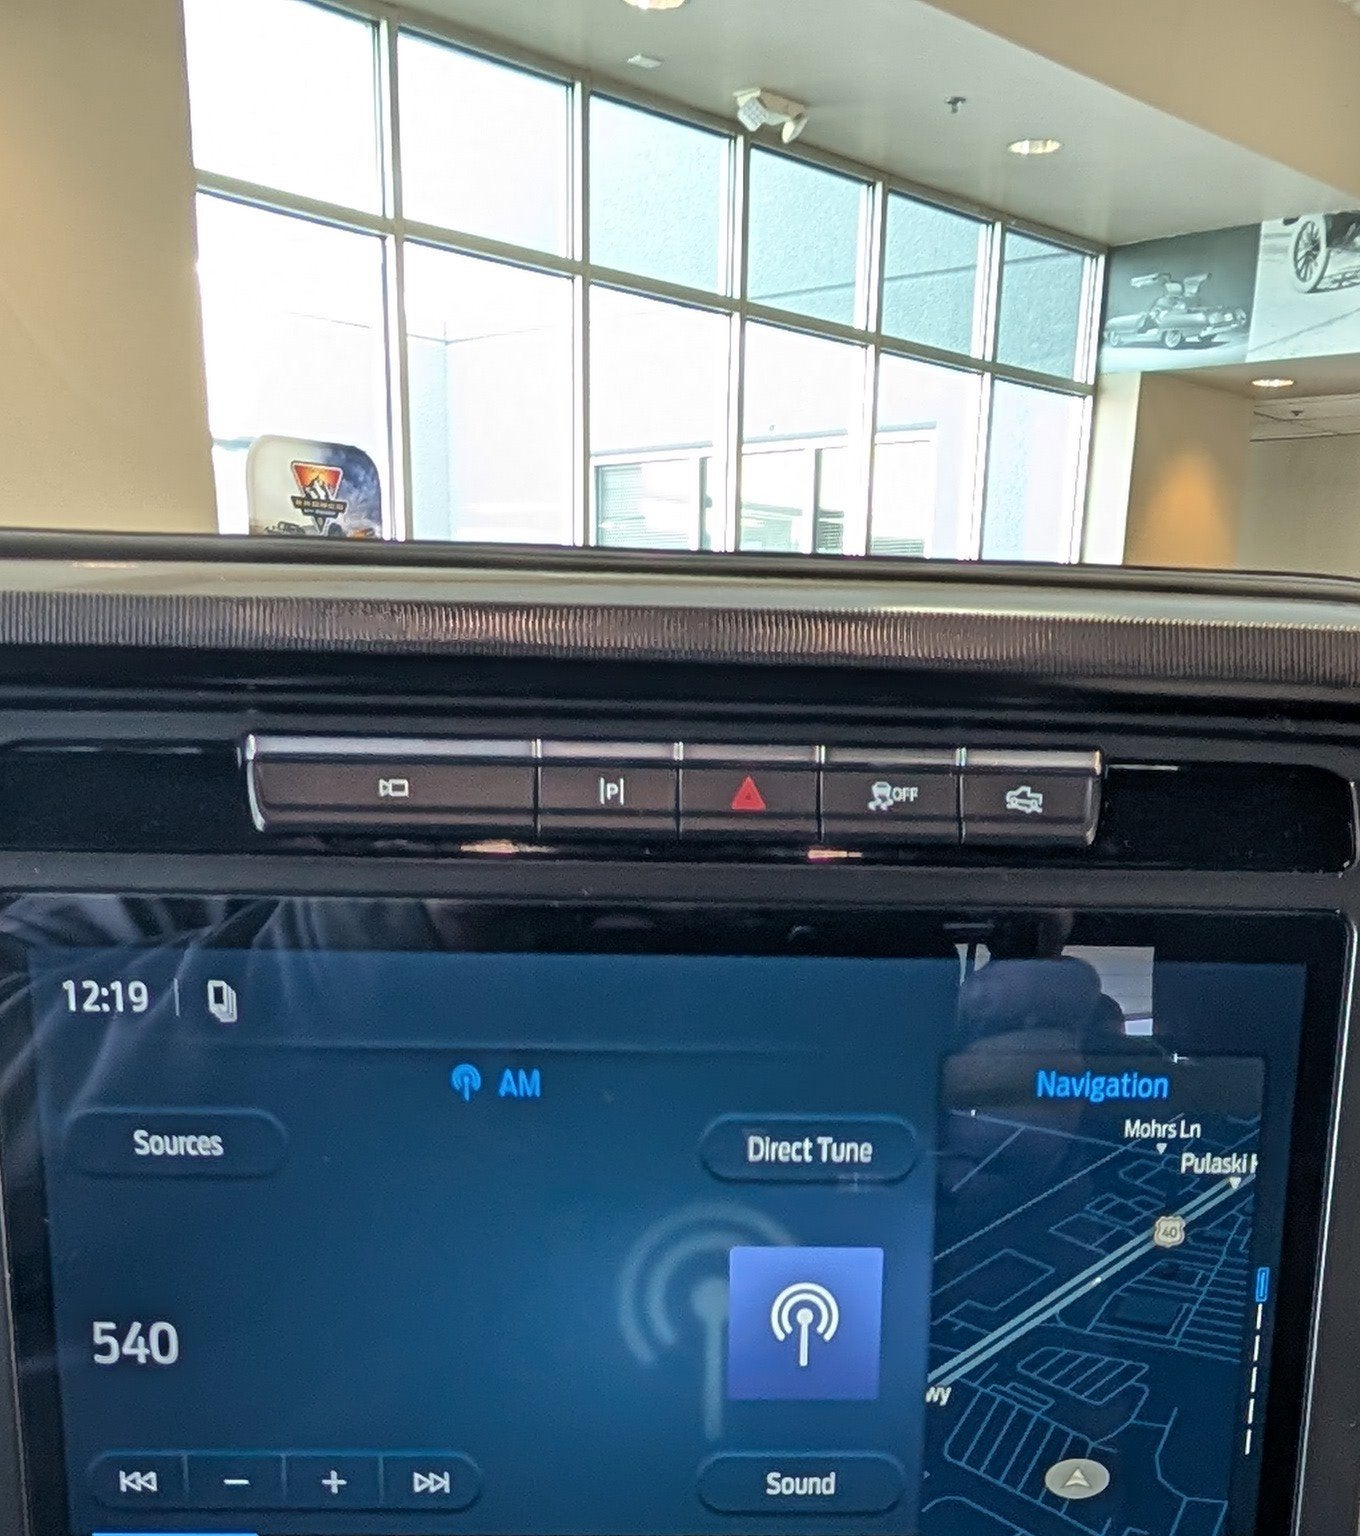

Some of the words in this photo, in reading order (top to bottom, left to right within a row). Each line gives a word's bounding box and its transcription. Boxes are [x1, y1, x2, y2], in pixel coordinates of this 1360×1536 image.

[892, 785, 919, 802] OFF
[62, 979, 149, 1013] 12:19
[498, 1068, 541, 1097] AM
[1037, 1070, 1169, 1103] Navigation
[1124, 1118, 1177, 1139] Mohrs
[1180, 1119, 1202, 1139] Ln
[133, 1129, 224, 1157] Sources
[748, 1135, 813, 1163] Direct
[816, 1136, 873, 1163] Tune
[1180, 1152, 1248, 1175] Pulaski
[1160, 1225, 1178, 1239] 40
[93, 1321, 179, 1365] 540
[766, 1471, 836, 1495] Sound
